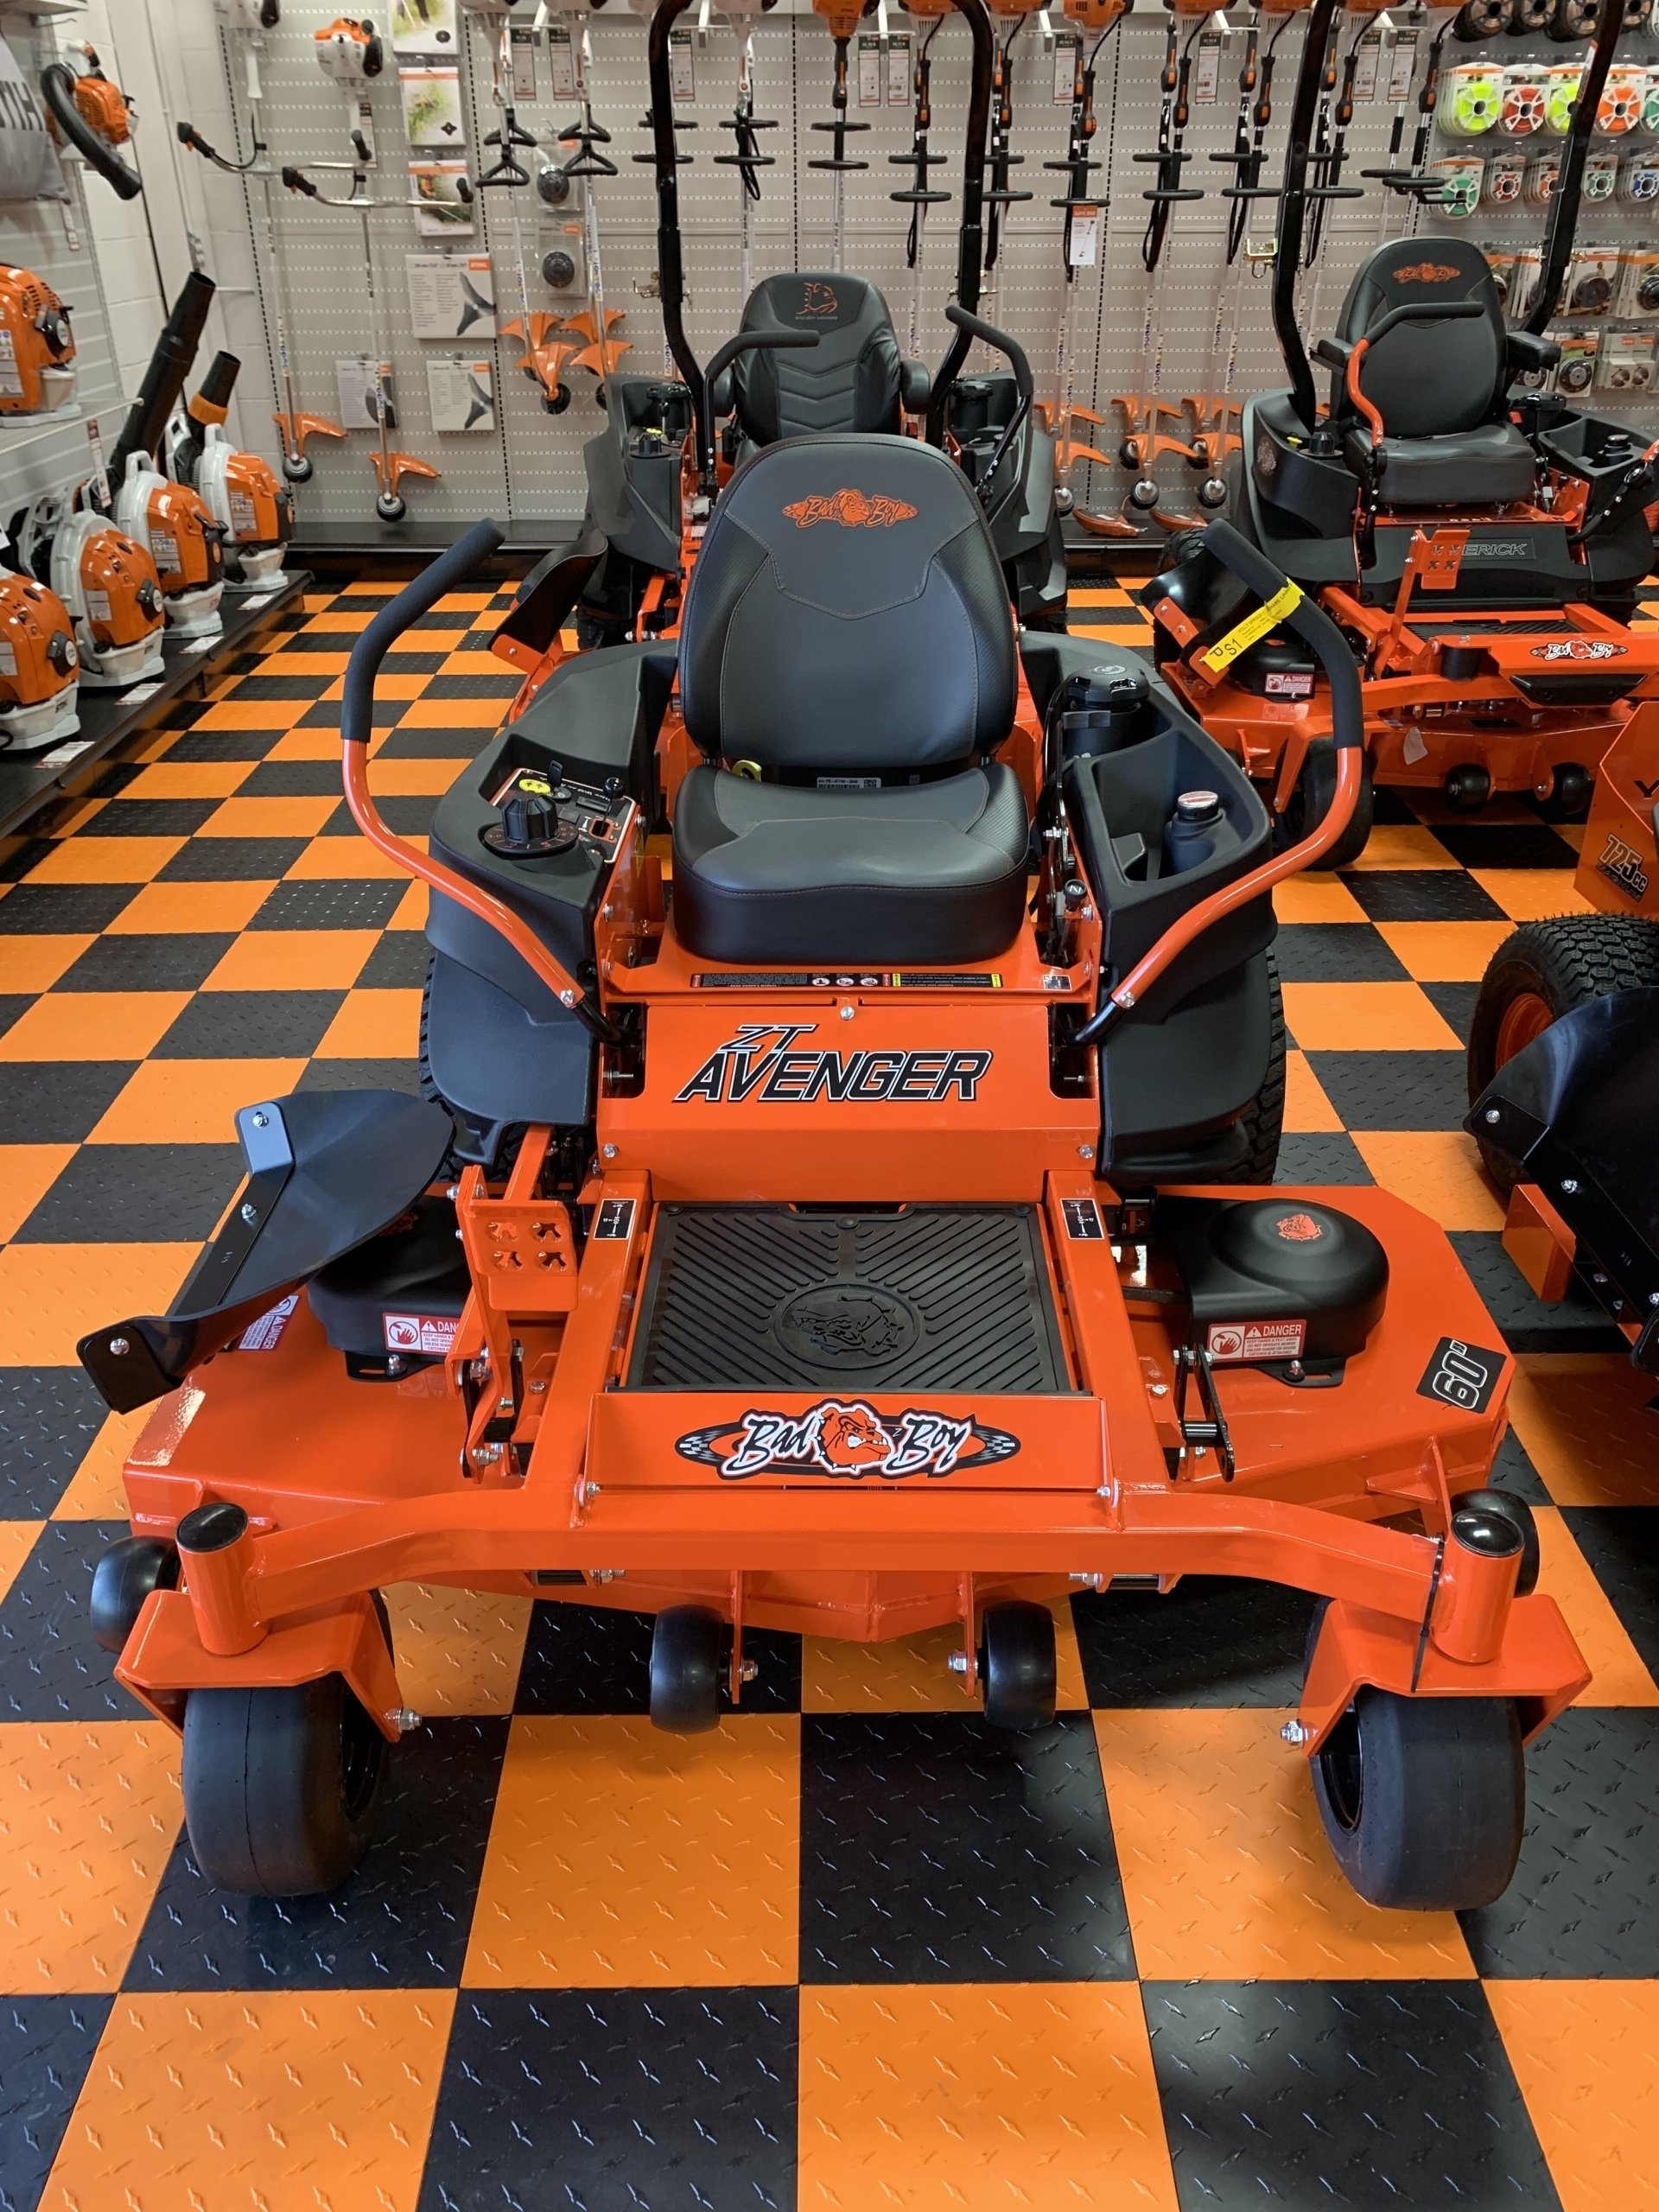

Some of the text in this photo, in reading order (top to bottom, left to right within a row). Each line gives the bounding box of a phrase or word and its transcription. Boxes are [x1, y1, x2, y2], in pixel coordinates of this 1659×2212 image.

[798, 495, 900, 528] Bad Boy
[1462, 543, 1528, 556] ERICK
[1544, 642, 1613, 660] Bad Boy
[715, 1023, 819, 1052] ZT
[671, 1049, 994, 1103] AVENGER
[261, 1325, 283, 1350] DANGER
[437, 1321, 460, 1333] DAN
[1263, 1324, 1302, 1337] DANGER
[724, 1408, 974, 1476] Bad Boy
